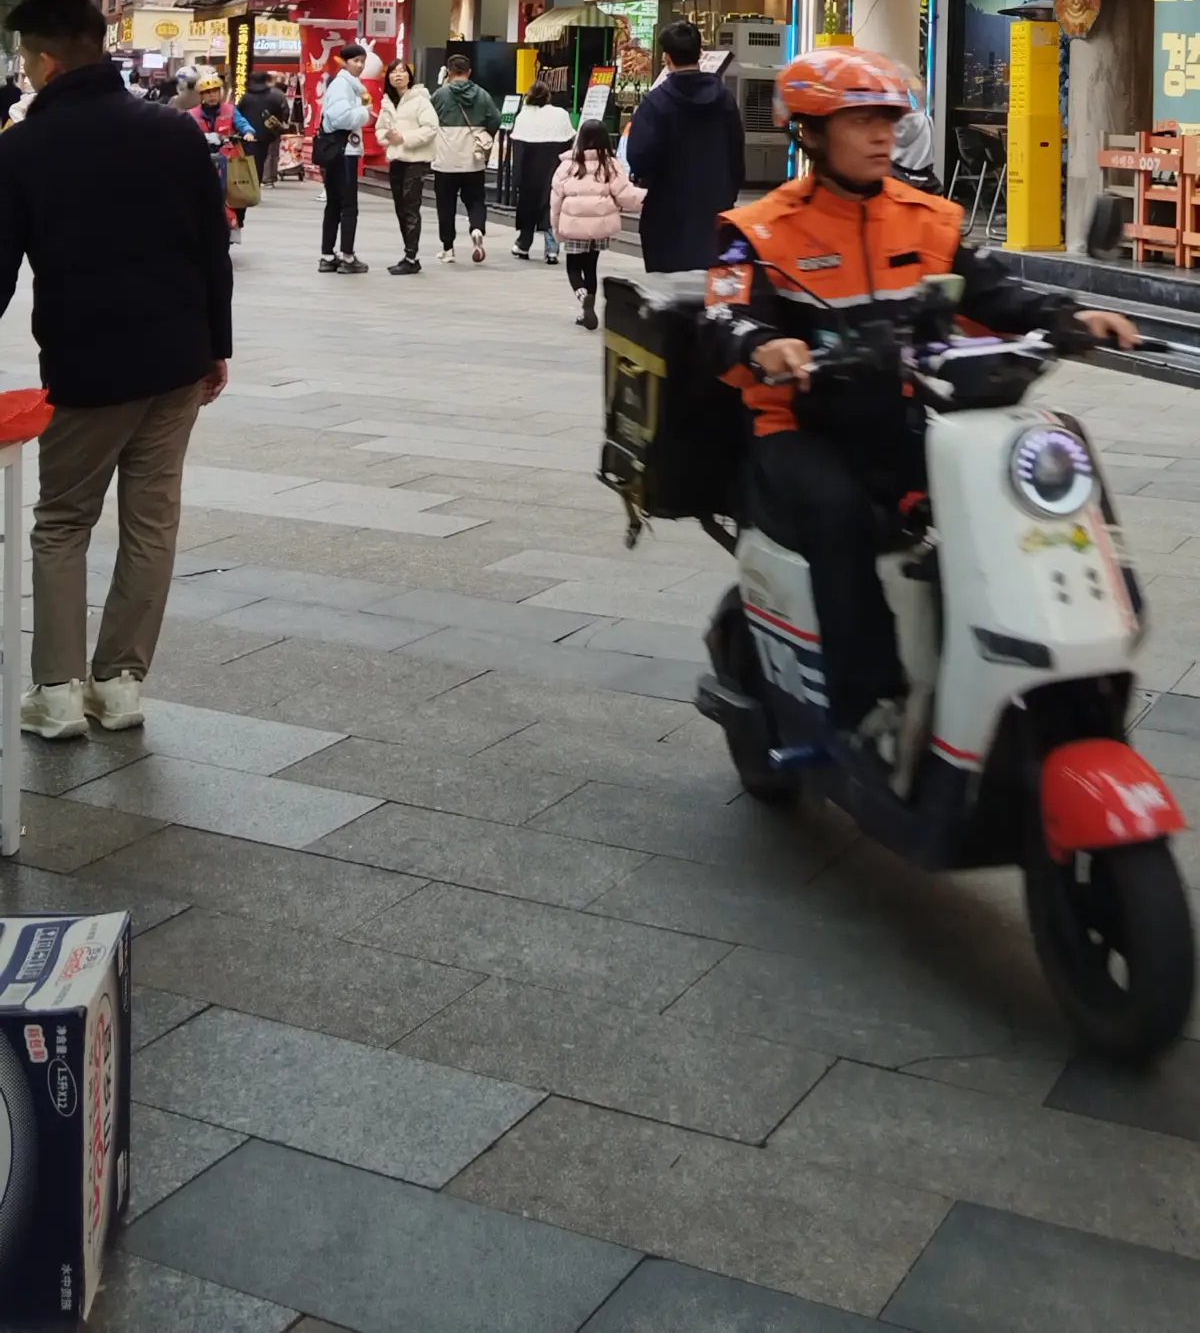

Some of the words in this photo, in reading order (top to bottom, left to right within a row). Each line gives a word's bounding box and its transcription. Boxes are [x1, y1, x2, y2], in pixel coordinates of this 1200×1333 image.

[1139, 157, 1161, 170] 007
[61, 1263, 72, 1310] 水中贵族
